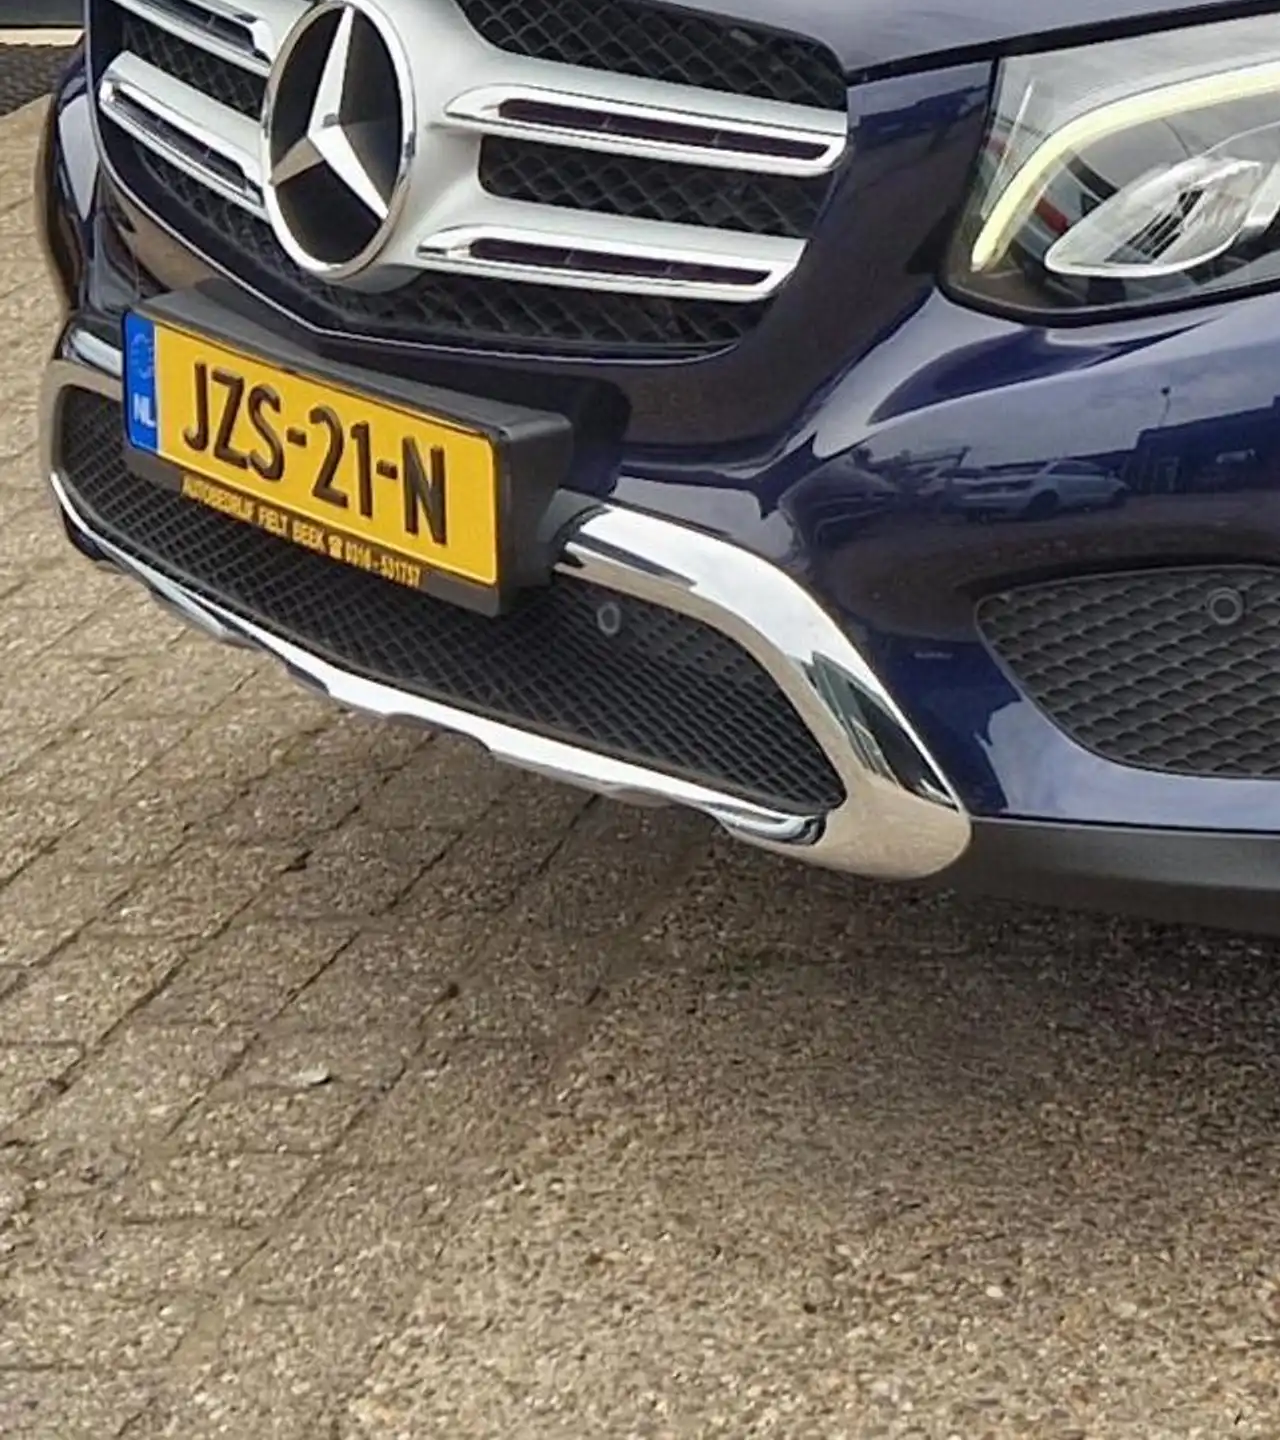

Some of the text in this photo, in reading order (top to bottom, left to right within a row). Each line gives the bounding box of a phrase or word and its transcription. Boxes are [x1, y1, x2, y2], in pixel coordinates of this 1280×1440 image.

[133, 393, 156, 428] NL
[183, 360, 447, 547] JZS-21-N
[292, 519, 327, 554] BEEK
